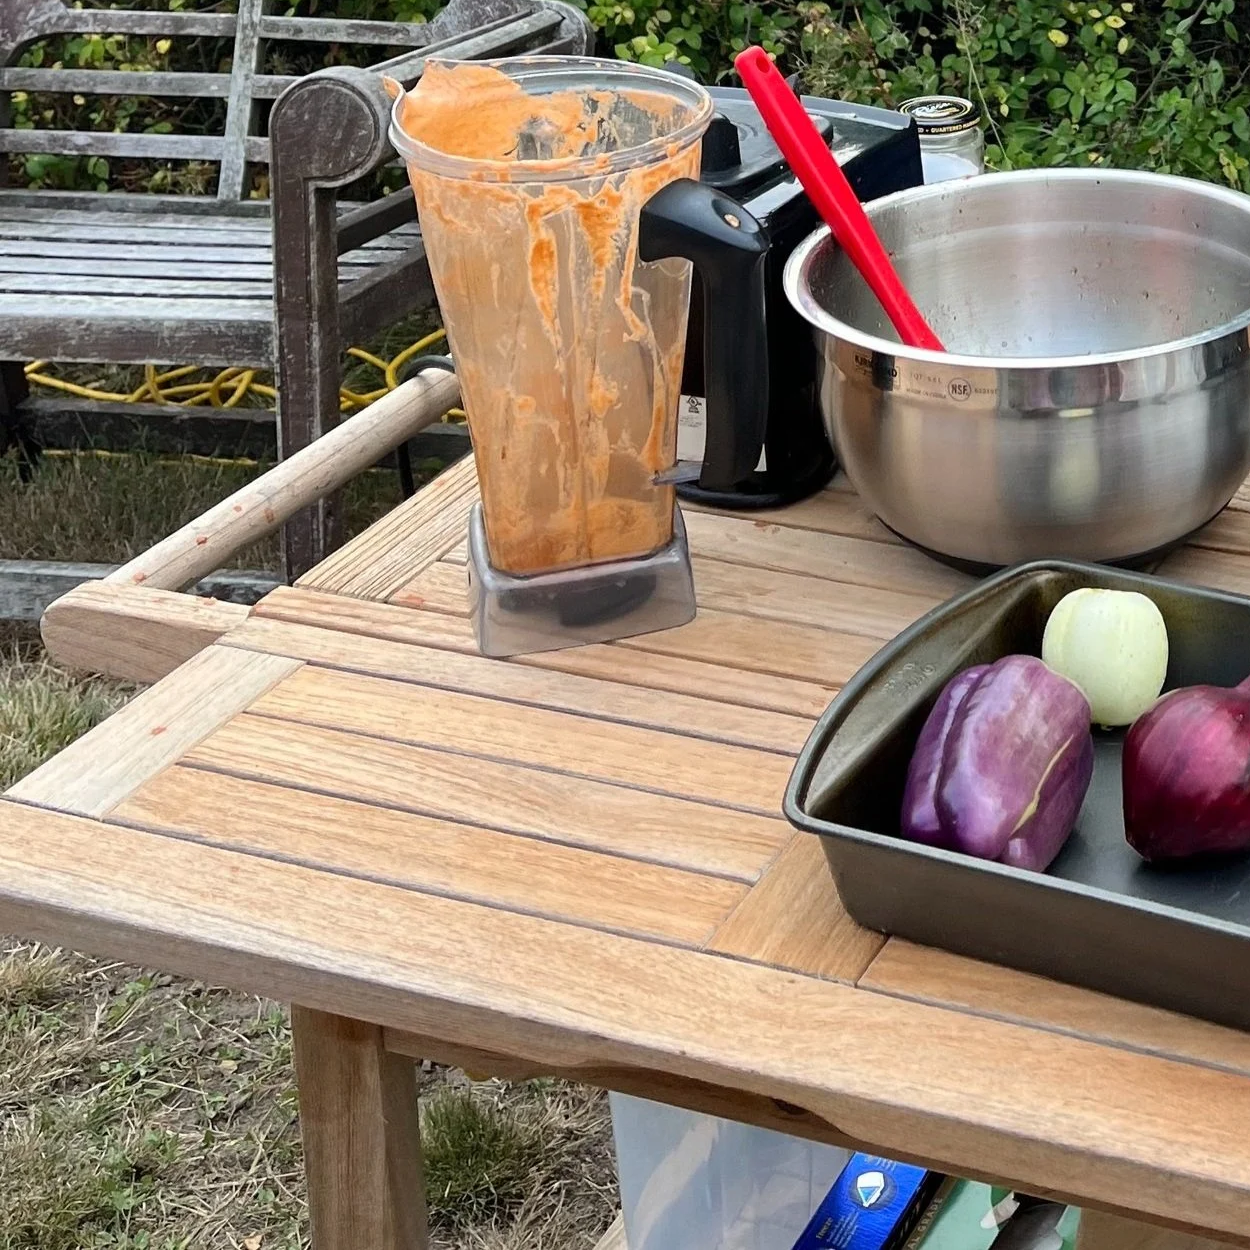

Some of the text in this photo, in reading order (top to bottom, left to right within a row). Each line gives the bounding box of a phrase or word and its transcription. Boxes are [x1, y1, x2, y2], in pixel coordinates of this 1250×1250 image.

[931, 123, 963, 134] QUARTERED
[951, 383, 969, 397] NSF
[907, 1197, 943, 1250] AL GRADE
